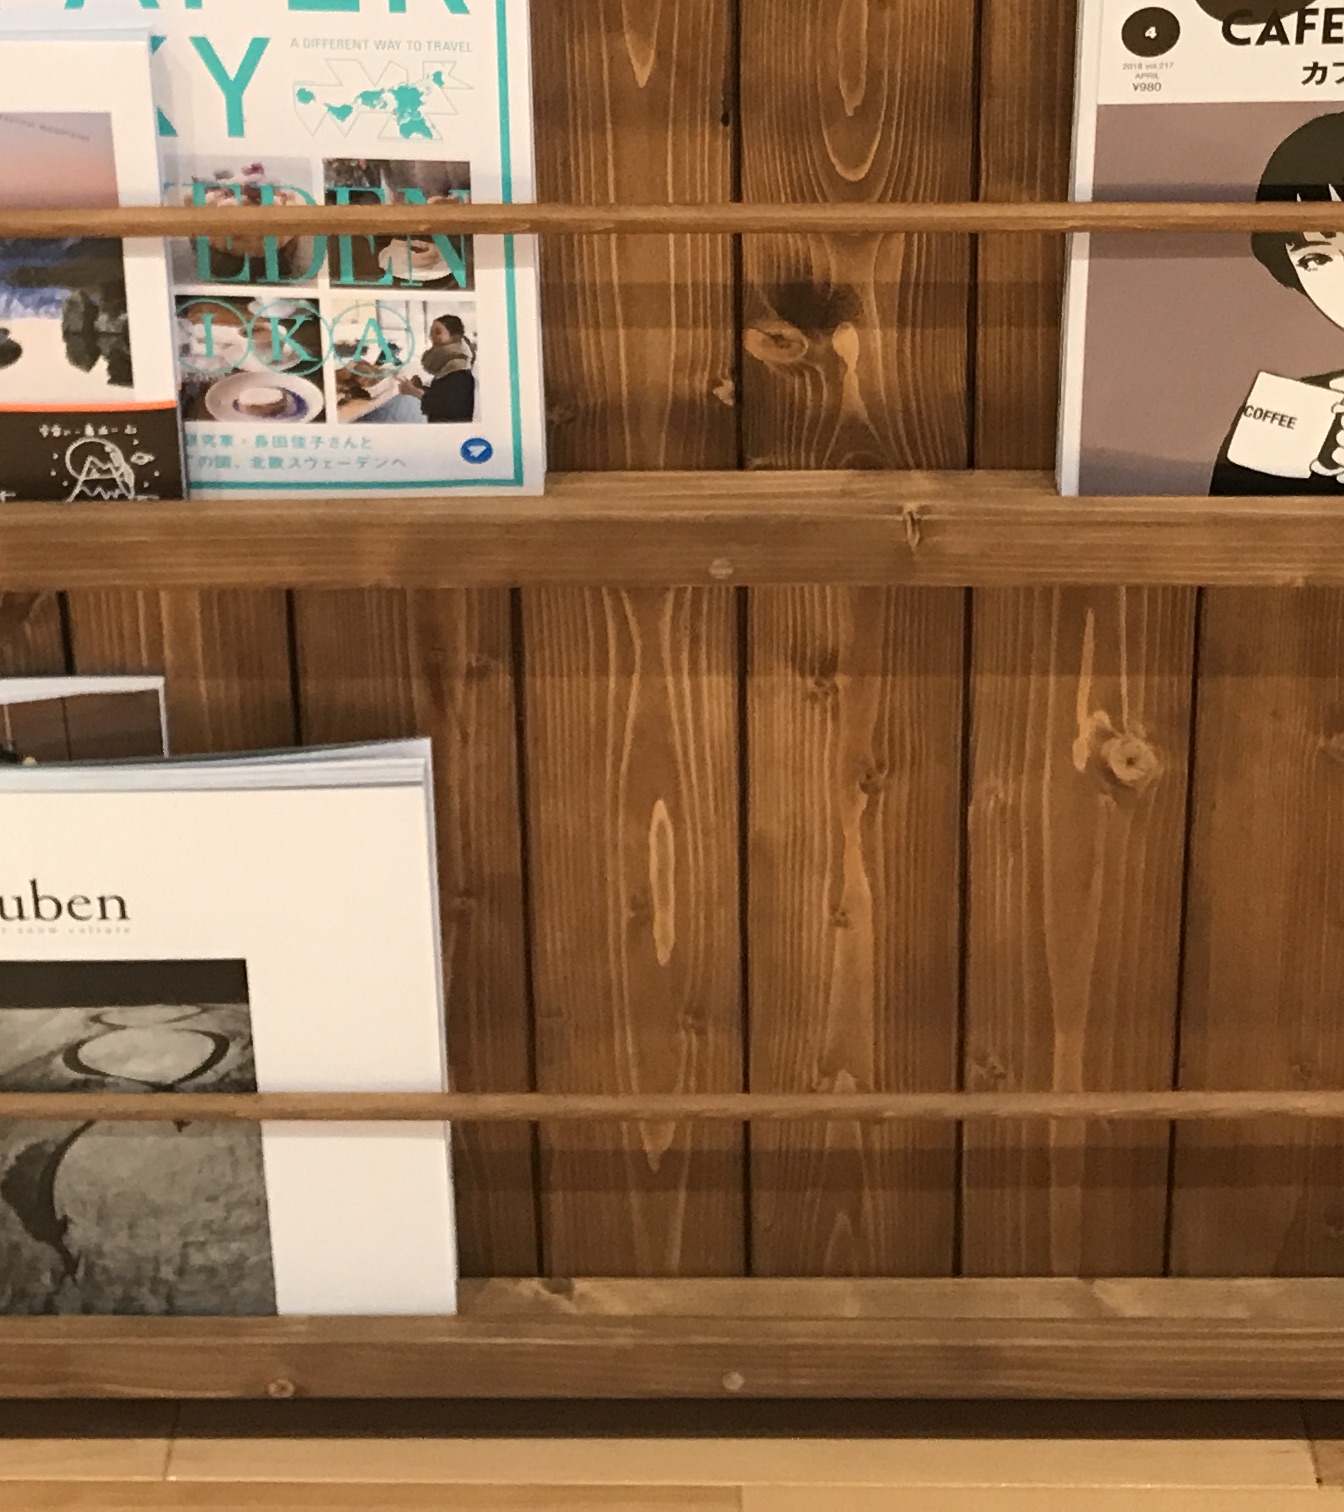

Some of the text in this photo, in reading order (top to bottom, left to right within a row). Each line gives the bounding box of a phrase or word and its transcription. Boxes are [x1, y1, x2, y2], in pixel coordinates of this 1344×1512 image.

[1144, 26, 1158, 39] 4
[290, 37, 473, 53] A DIFFERENT WAY TO TRAVEL
[1132, 82, 1162, 92] ¥980
[1243, 405, 1298, 430] COFFEE
